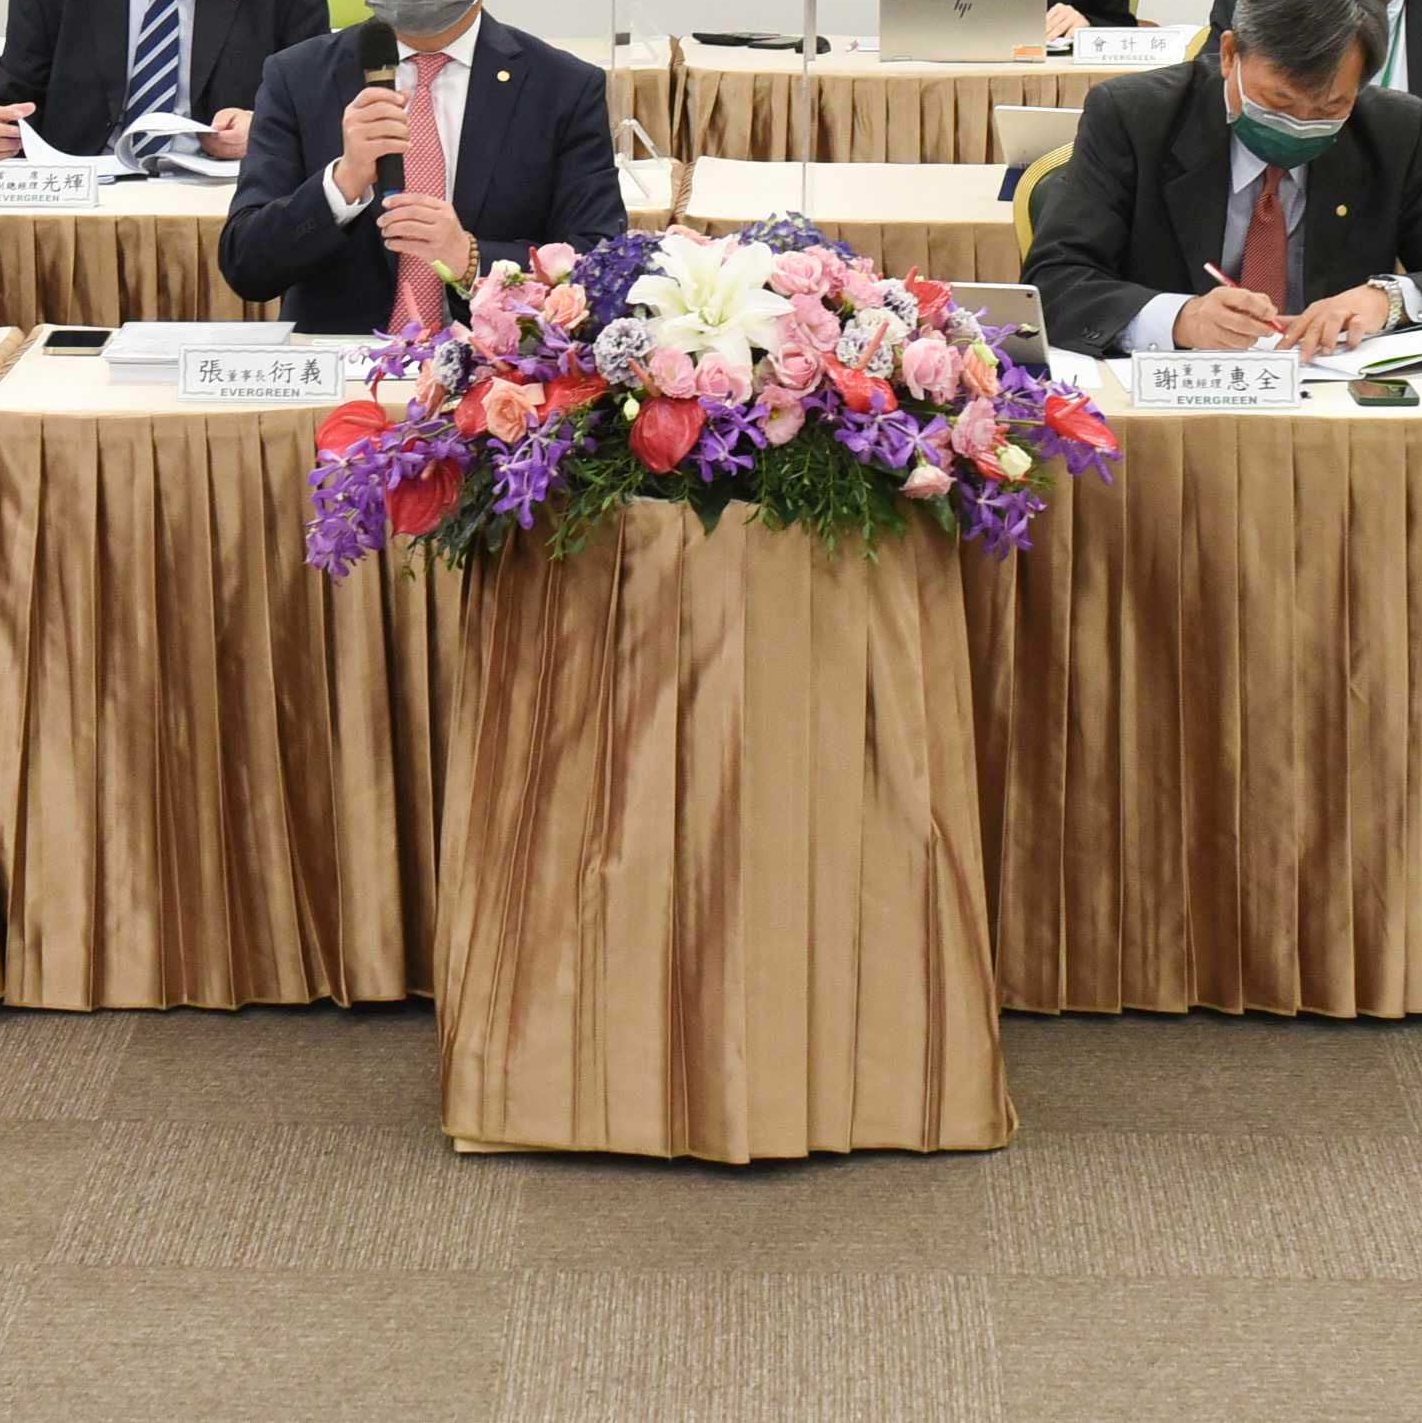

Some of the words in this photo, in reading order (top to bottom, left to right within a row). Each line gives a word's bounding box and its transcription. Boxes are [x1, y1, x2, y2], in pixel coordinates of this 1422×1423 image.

[1092, 36, 1167, 52] 會計師
[220, 388, 300, 397] EVERGREEN
[1177, 396, 1258, 405] EVERGREEN
